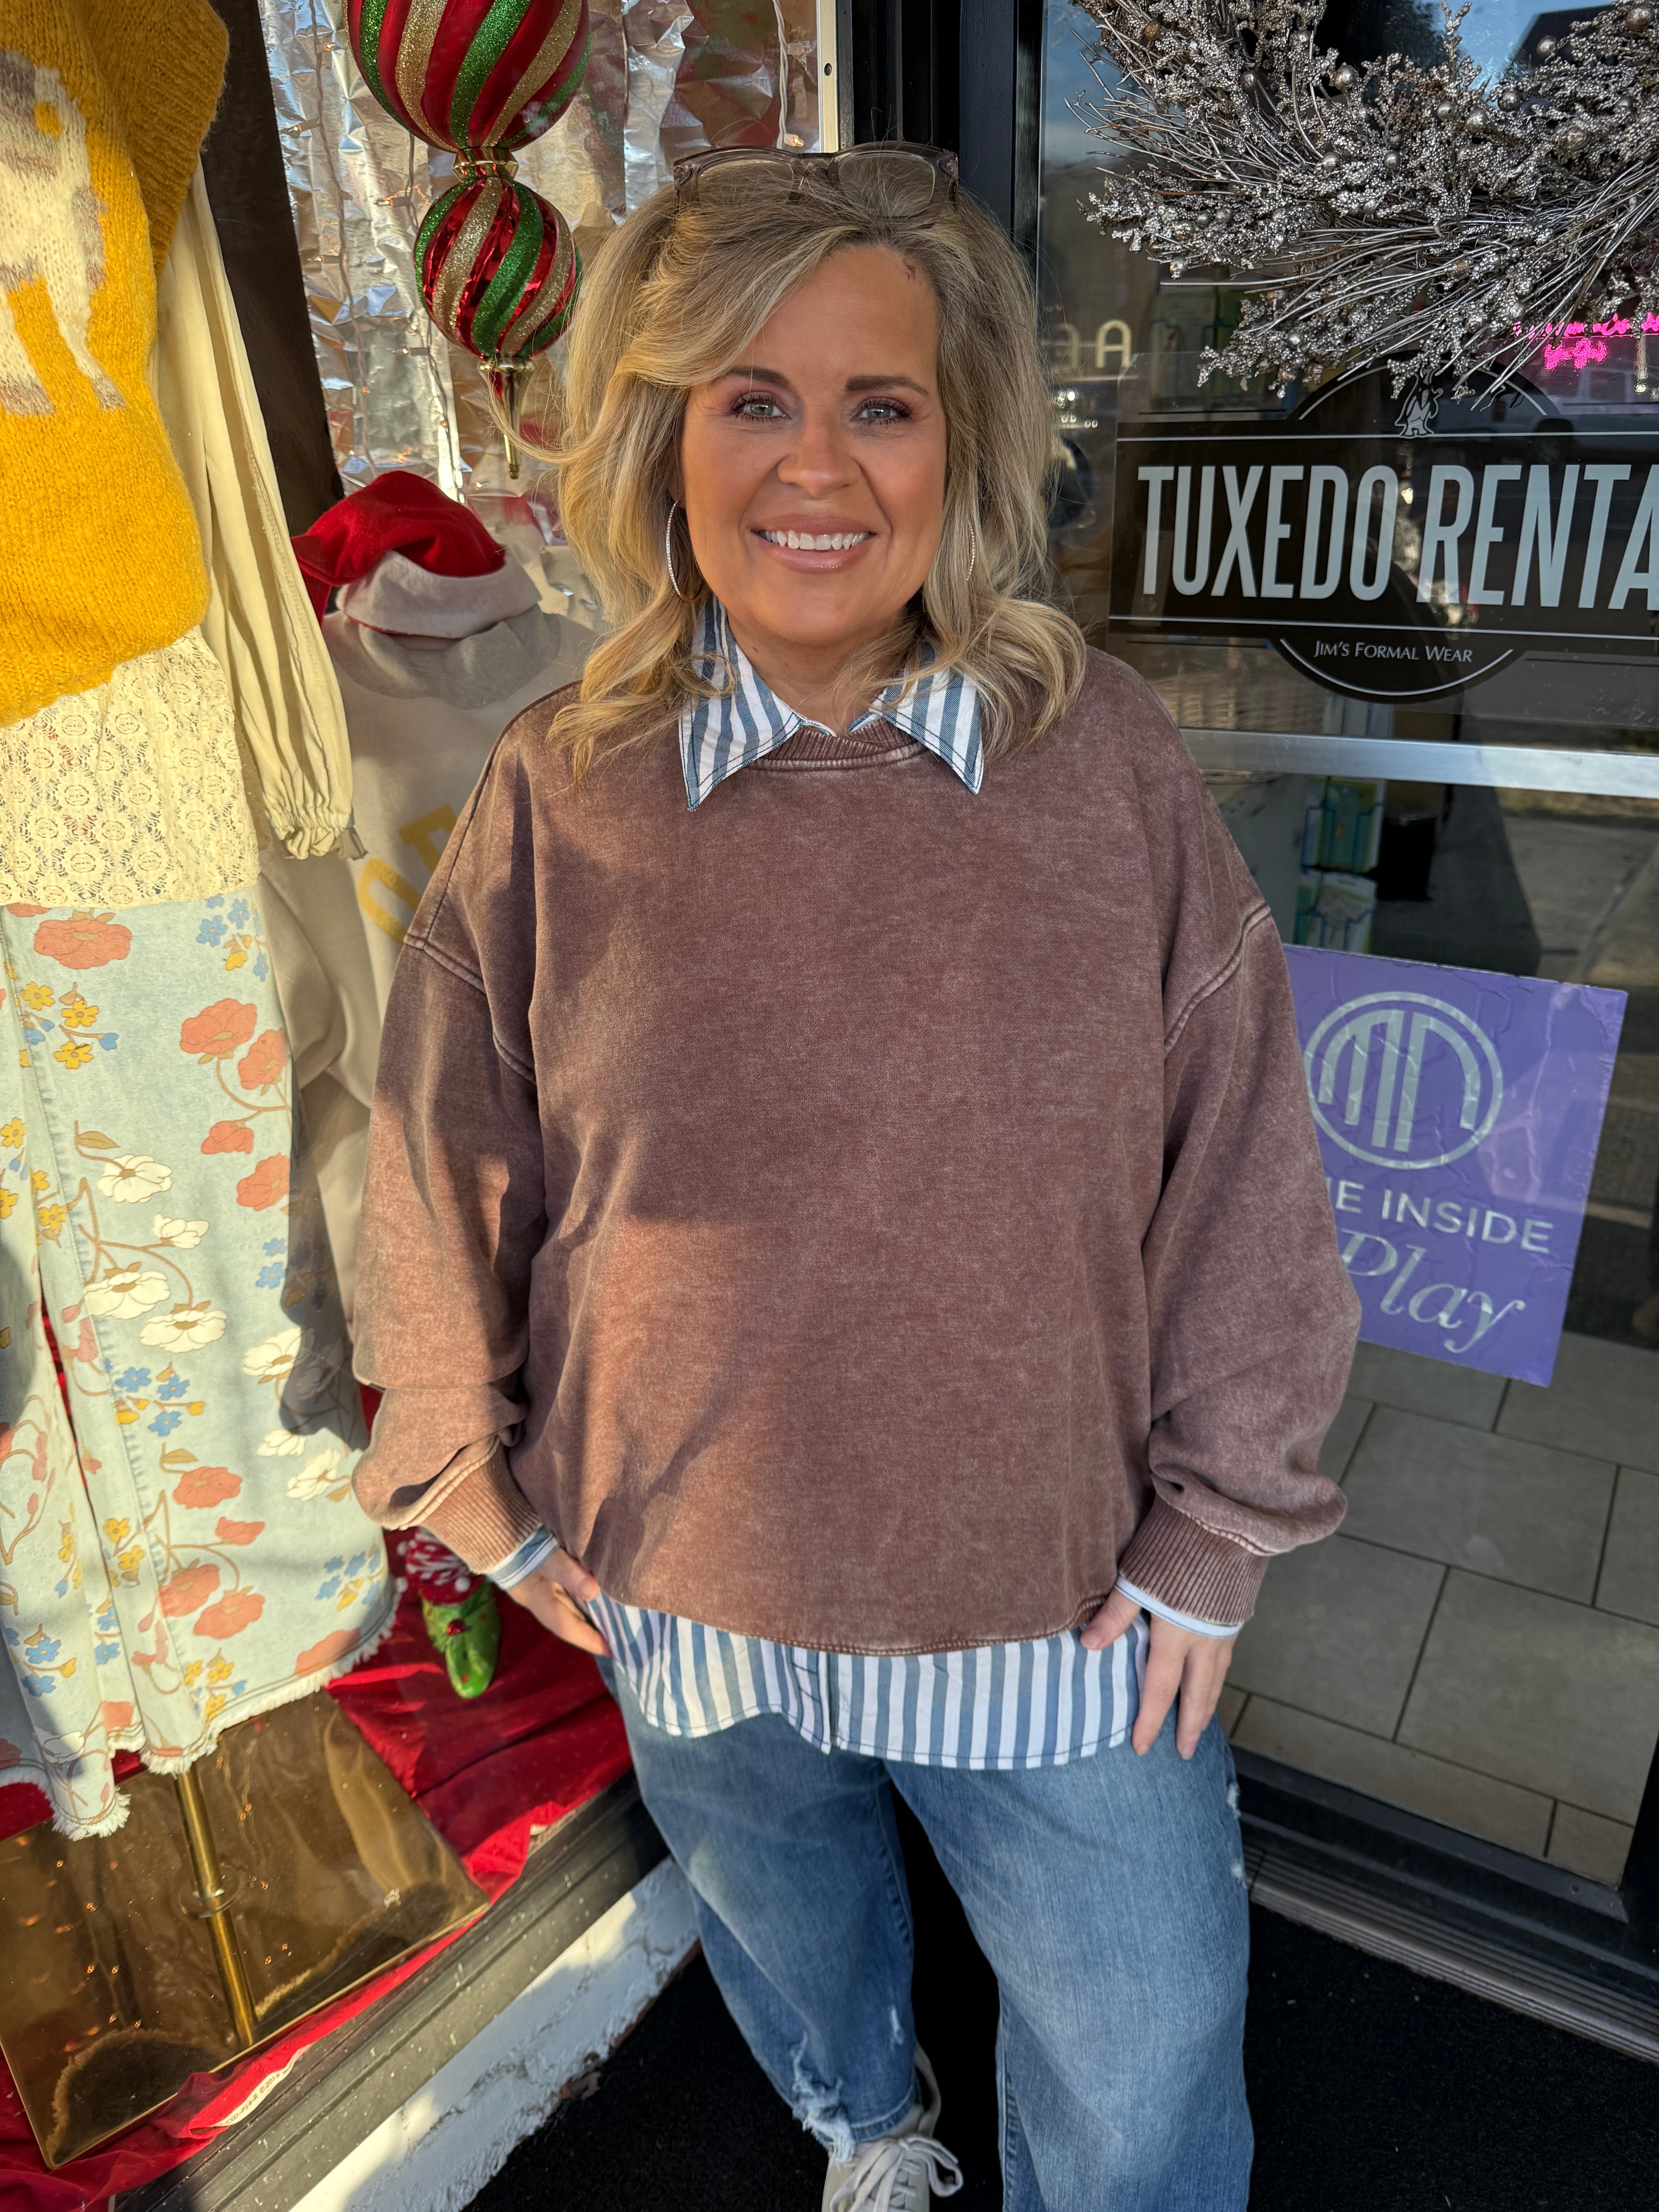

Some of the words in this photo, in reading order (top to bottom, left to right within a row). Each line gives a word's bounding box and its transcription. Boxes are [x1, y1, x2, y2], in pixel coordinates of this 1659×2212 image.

[1138, 465, 1399, 601] TUXEDO
[1355, 641, 1420, 661] FORMAL
[1425, 646, 1472, 663] WEAR
[1382, 1189, 1554, 1254] INSIDE
